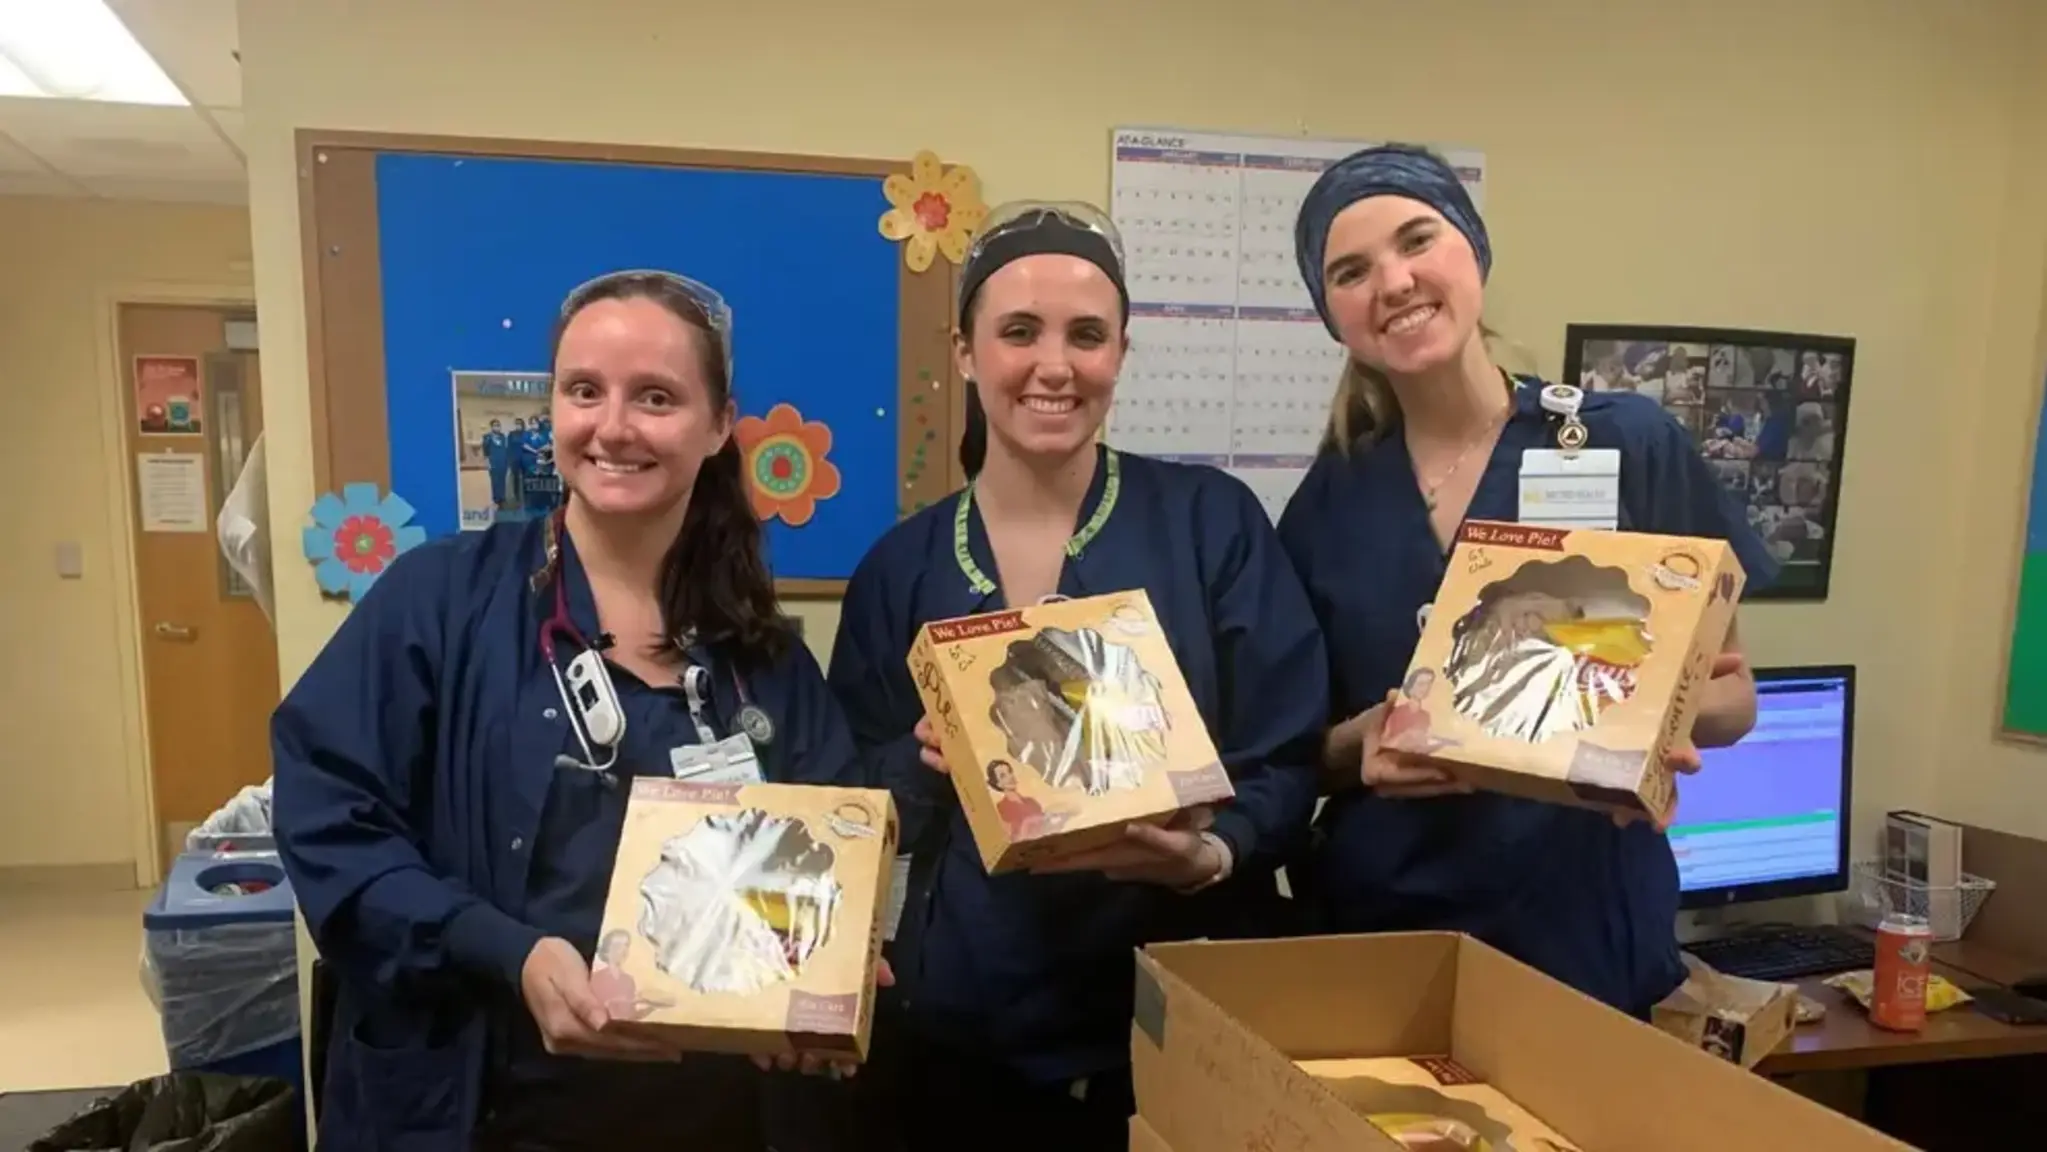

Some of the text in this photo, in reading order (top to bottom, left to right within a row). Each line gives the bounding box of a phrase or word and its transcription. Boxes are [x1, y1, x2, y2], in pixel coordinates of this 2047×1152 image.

[1467, 526, 1557, 546] We Love Pie!
[934, 617, 1018, 640] We Love Pie!
[663, 784, 697, 800] Love
[700, 785, 731, 802] Pie!
